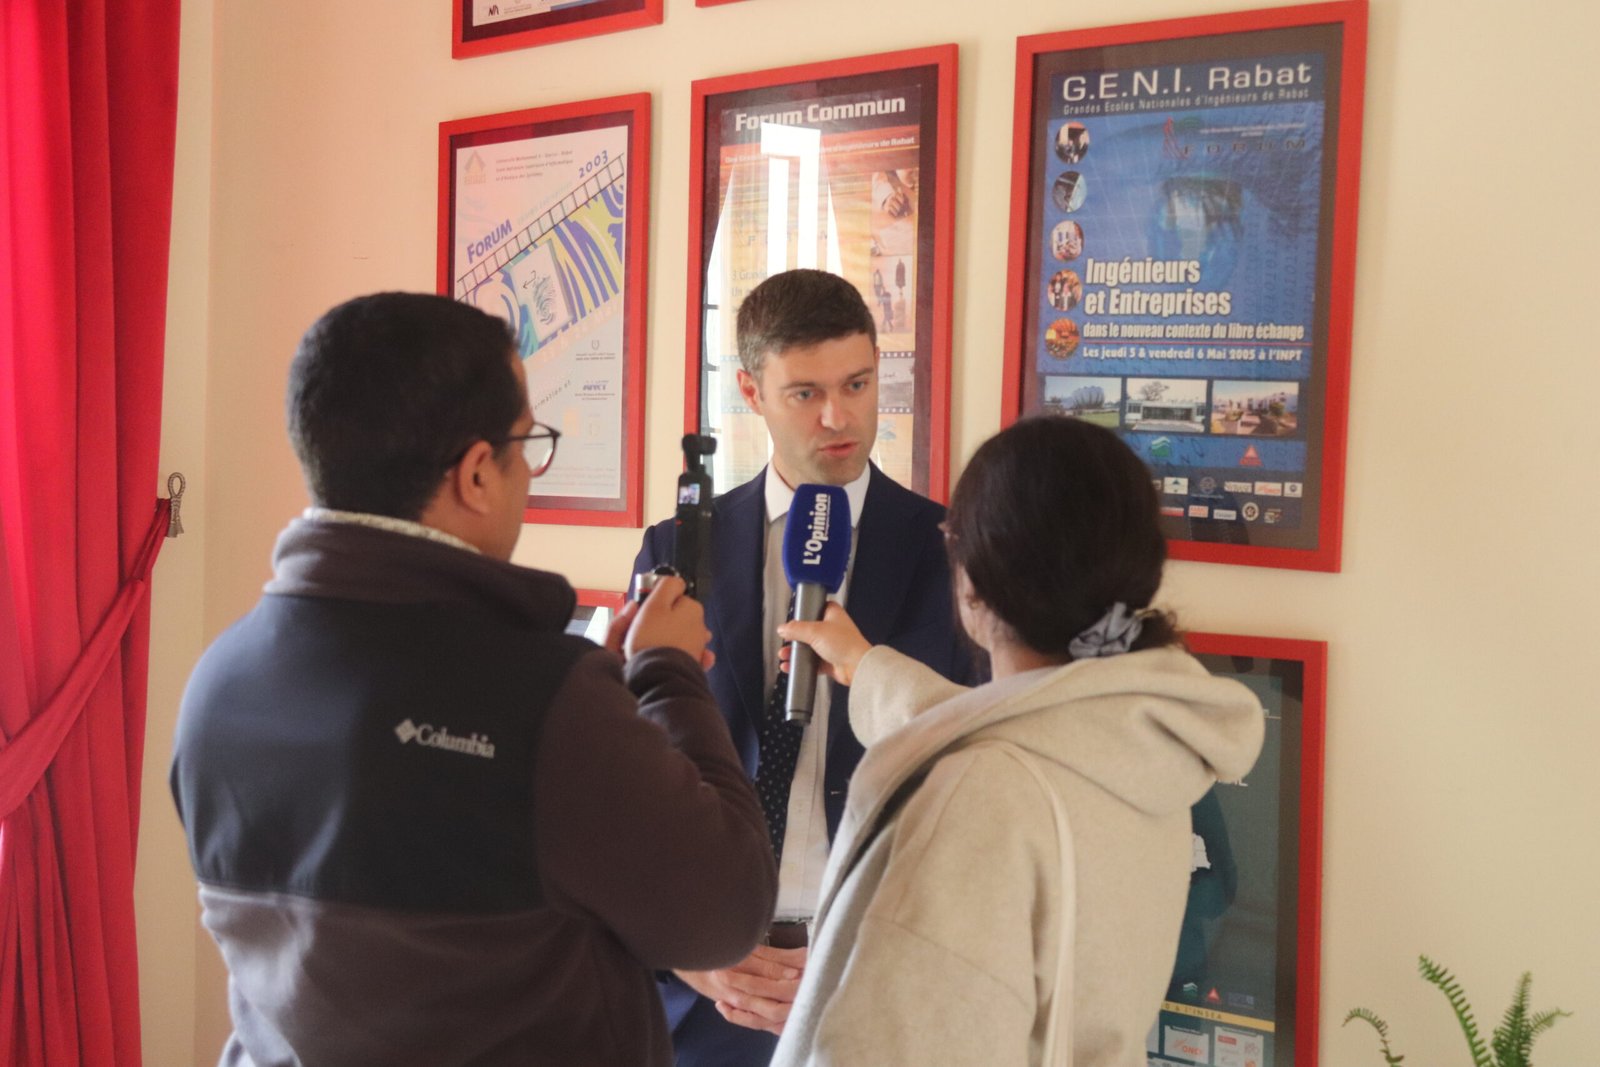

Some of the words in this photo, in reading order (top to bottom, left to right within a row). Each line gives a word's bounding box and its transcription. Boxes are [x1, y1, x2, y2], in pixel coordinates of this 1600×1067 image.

[1063, 68, 1192, 101] G.E.N.I.
[1209, 63, 1313, 90] Rabat
[735, 110, 803, 132] Forum
[807, 96, 906, 124] Commun
[1063, 104, 1101, 116] Grandes
[1139, 97, 1191, 110] Nationales
[1262, 90, 1274, 101] de
[1278, 88, 1309, 99] Rabat
[578, 150, 609, 179] 2003
[466, 218, 513, 265] FORUM
[1085, 257, 1201, 288] Ingénieurs
[1084, 291, 1105, 315] et
[1109, 288, 1232, 317] Entreprises
[1083, 323, 1108, 338] dans
[1109, 323, 1120, 338] le
[1120, 324, 1164, 338] nouveau
[1165, 323, 1212, 339] contexte
[1213, 323, 1227, 339] du
[1228, 323, 1254, 339] libre
[1256, 322, 1304, 342] échange
[1083, 346, 1099, 358] Les
[1101, 346, 1127, 359] jeudi
[1129, 347, 1136, 358] 5
[1148, 347, 1194, 360] vendredi
[1197, 348, 1205, 360] 6
[1207, 348, 1226, 360] Mai
[1229, 349, 1255, 360] 2005
[1259, 348, 1266, 360] à
[802, 493, 830, 565] L'Opinion
[416, 723, 496, 760] Columbia
